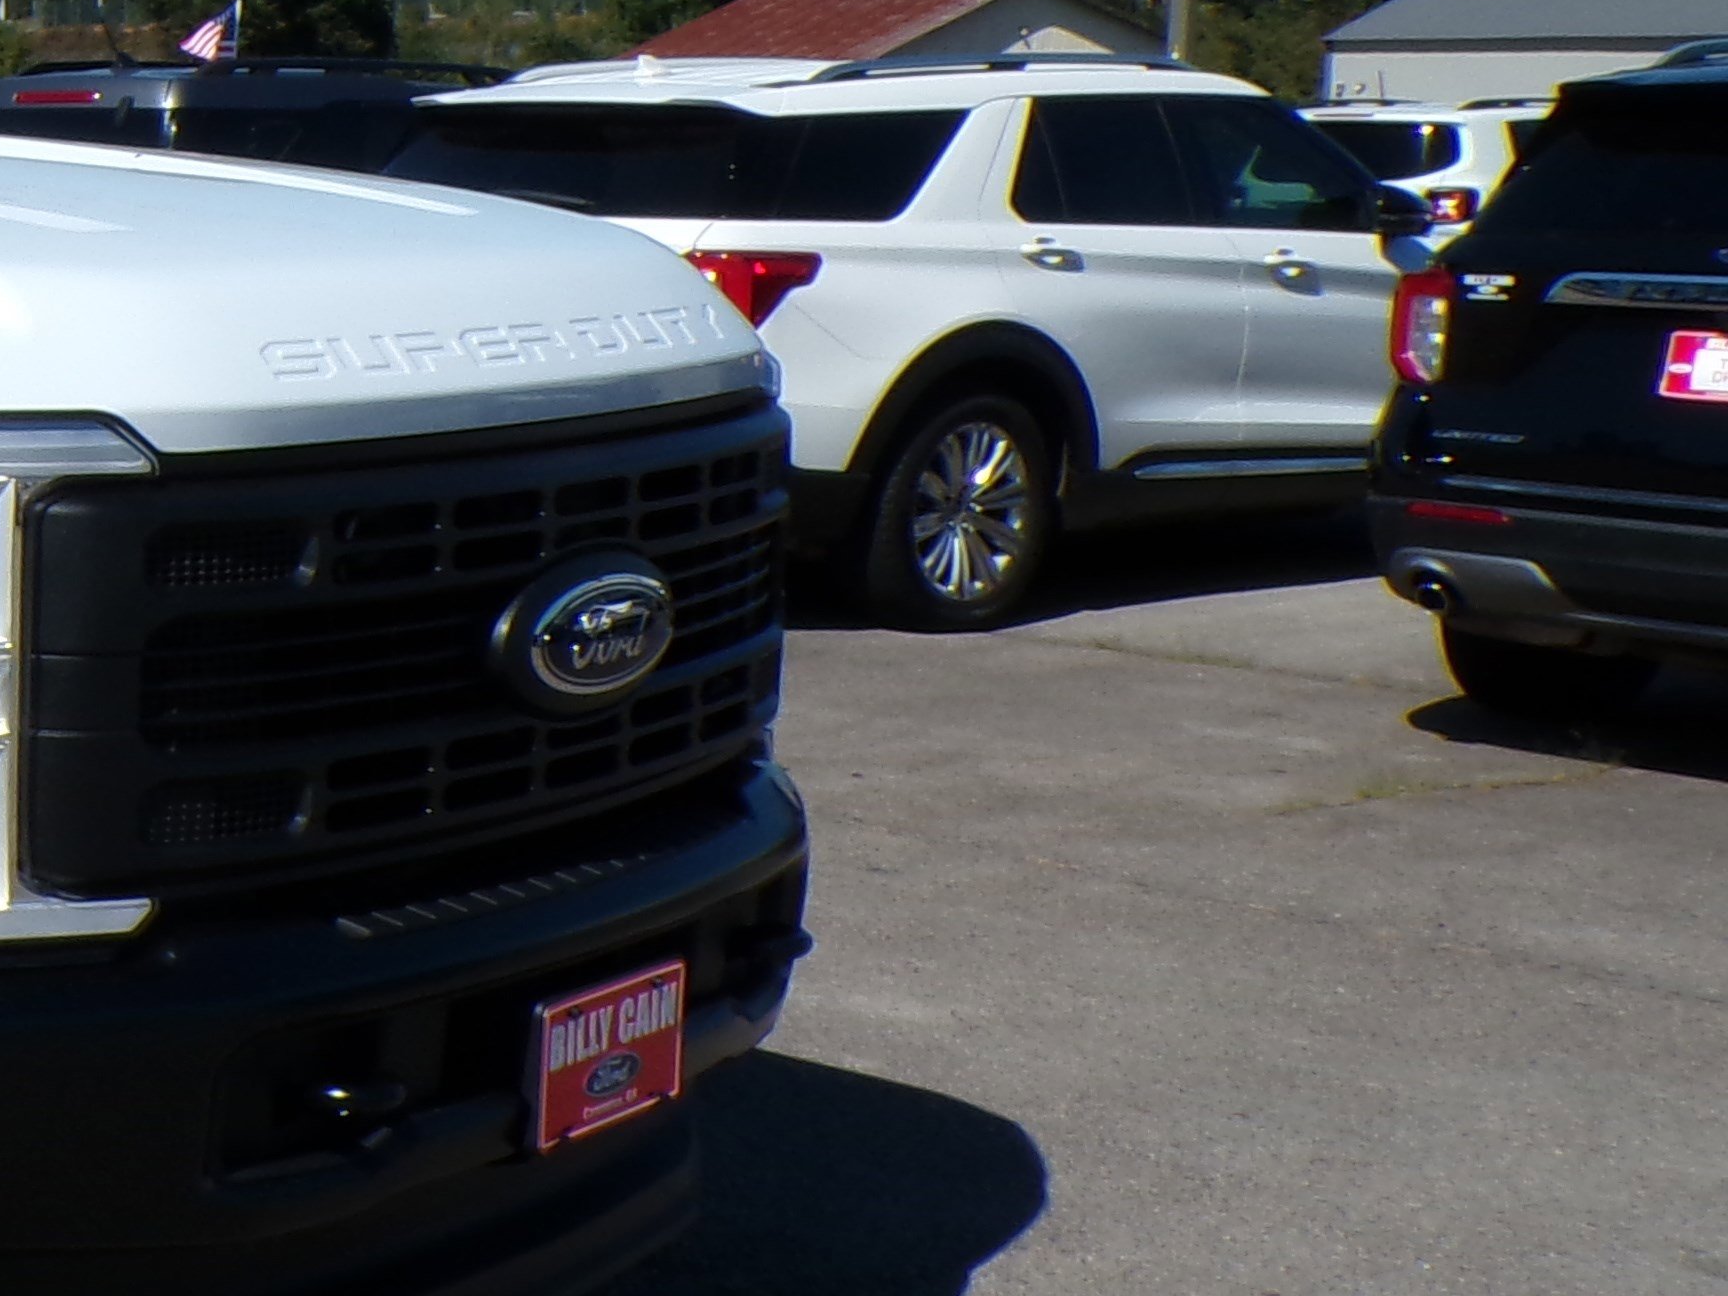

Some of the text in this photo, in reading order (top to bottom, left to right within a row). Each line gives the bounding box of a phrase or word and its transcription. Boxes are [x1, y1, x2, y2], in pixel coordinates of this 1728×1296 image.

[260, 305, 726, 381] SUPER DUTY
[569, 596, 652, 670] Ford
[550, 982, 677, 1072] BILLY CAIN
